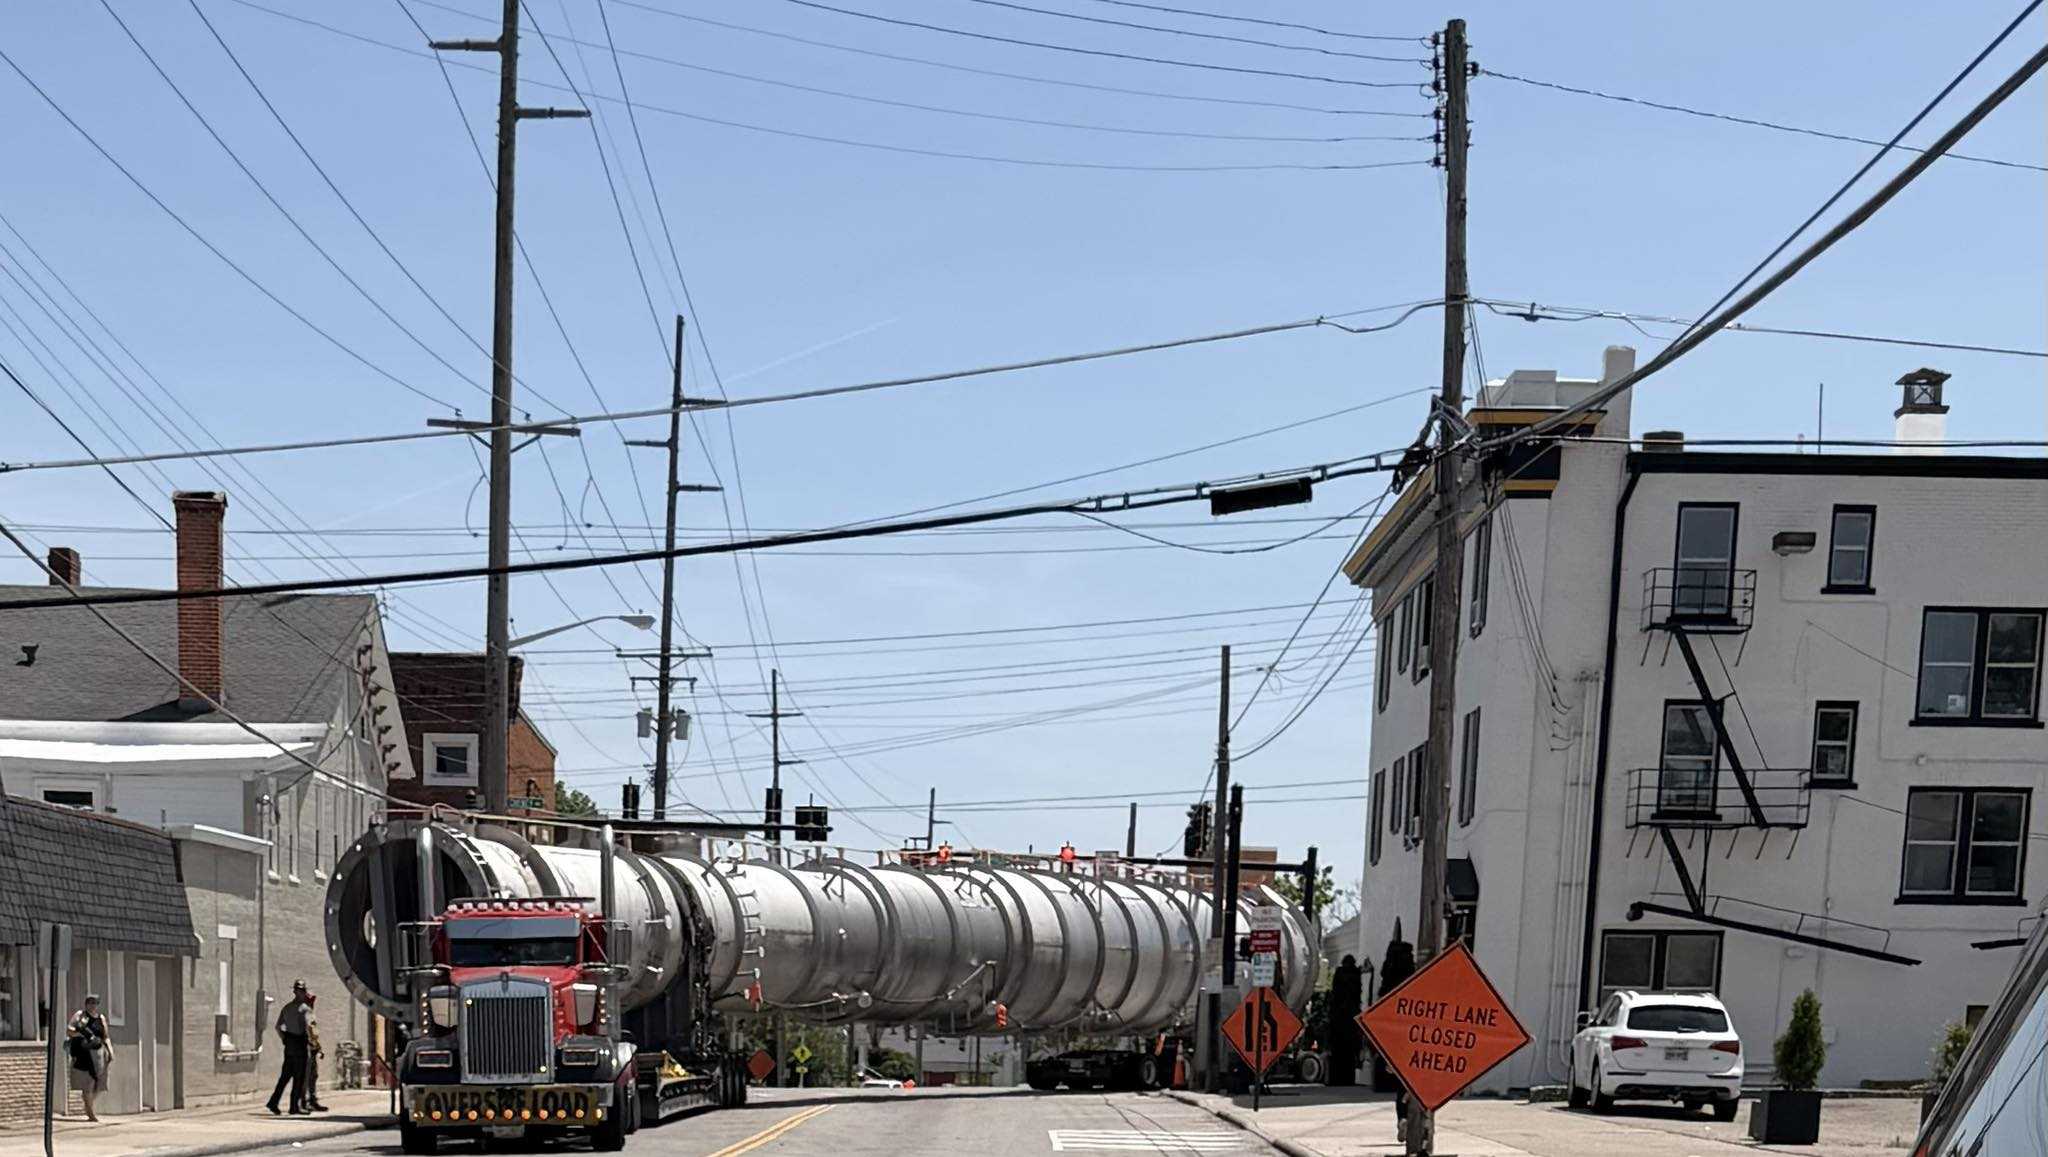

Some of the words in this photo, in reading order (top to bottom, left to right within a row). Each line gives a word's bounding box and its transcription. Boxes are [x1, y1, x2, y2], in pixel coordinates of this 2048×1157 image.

[1396, 998, 1448, 1020] RIGHT
[1454, 1005, 1498, 1026] LANE
[1409, 1025, 1476, 1049] CLOSED
[1409, 1051, 1466, 1073] AHEAD
[531, 1090, 588, 1118] LOAD
